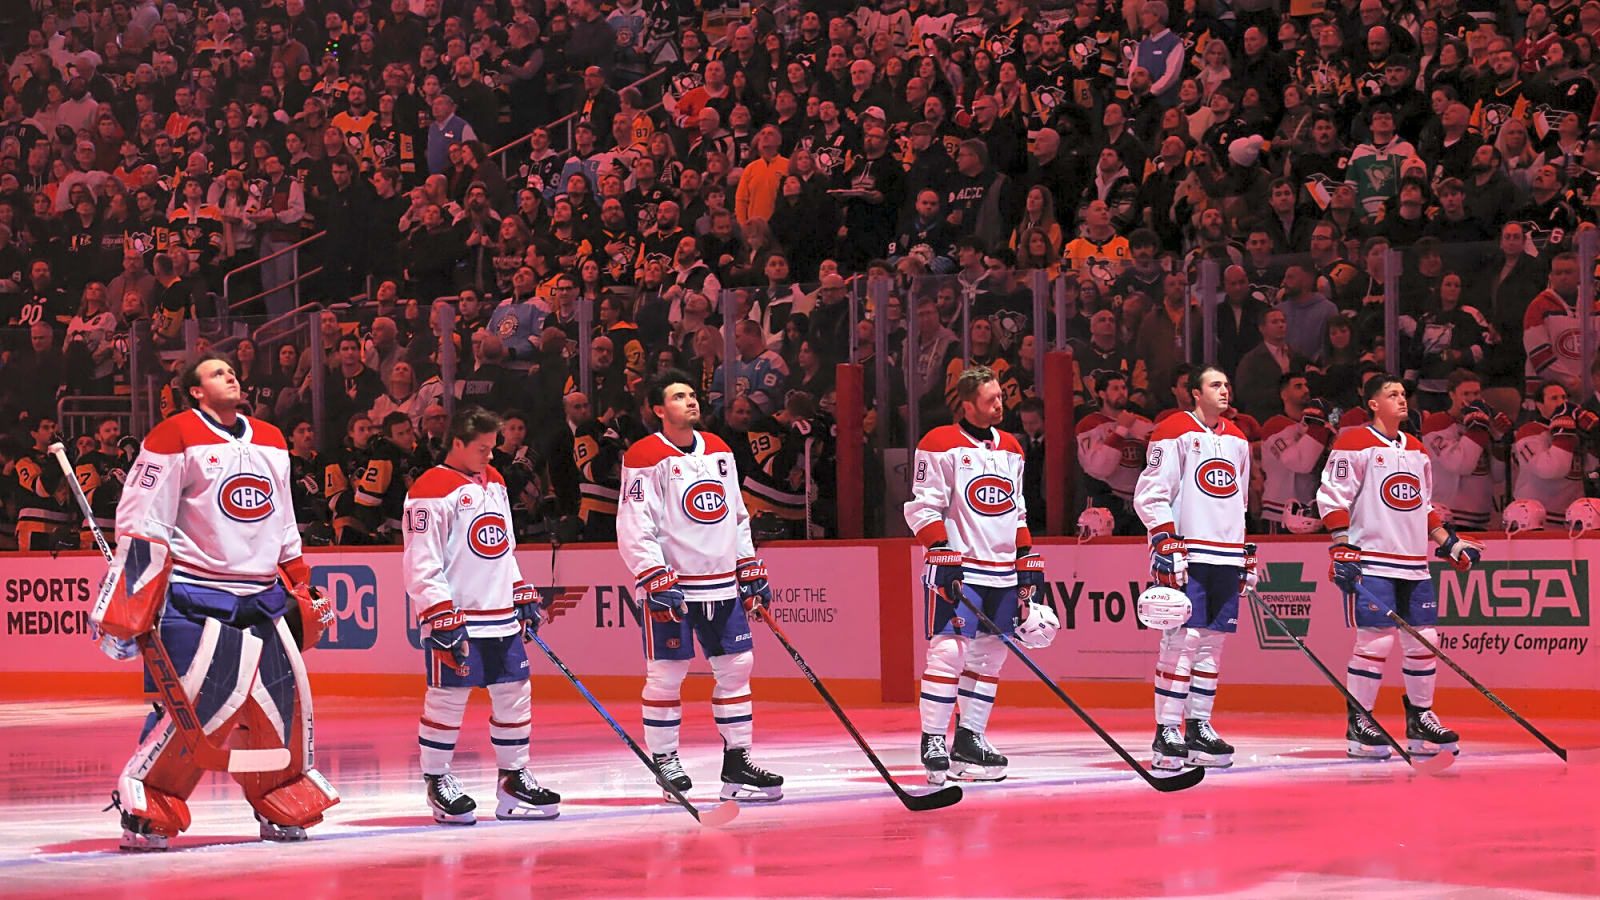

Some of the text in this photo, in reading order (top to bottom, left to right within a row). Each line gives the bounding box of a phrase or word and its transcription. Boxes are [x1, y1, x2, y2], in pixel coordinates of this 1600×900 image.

[751, 435, 770, 456] 39
[130, 462, 163, 490] 75
[717, 458, 729, 478] C
[622, 477, 644, 502] 14
[405, 508, 429, 533] 13
[6, 578, 90, 602] SPORTS
[96, 571, 116, 614] TRUE
[786, 588, 801, 603] OF
[803, 588, 827, 603] THE
[1262, 594, 1311, 603] PENNSYLVANIA
[1437, 569, 1581, 617] MSA
[1088, 592, 1126, 623] TO
[1437, 632, 1589, 655] he Safety Company
[147, 636, 195, 732] TRUE
[137, 721, 177, 775] TRUE
